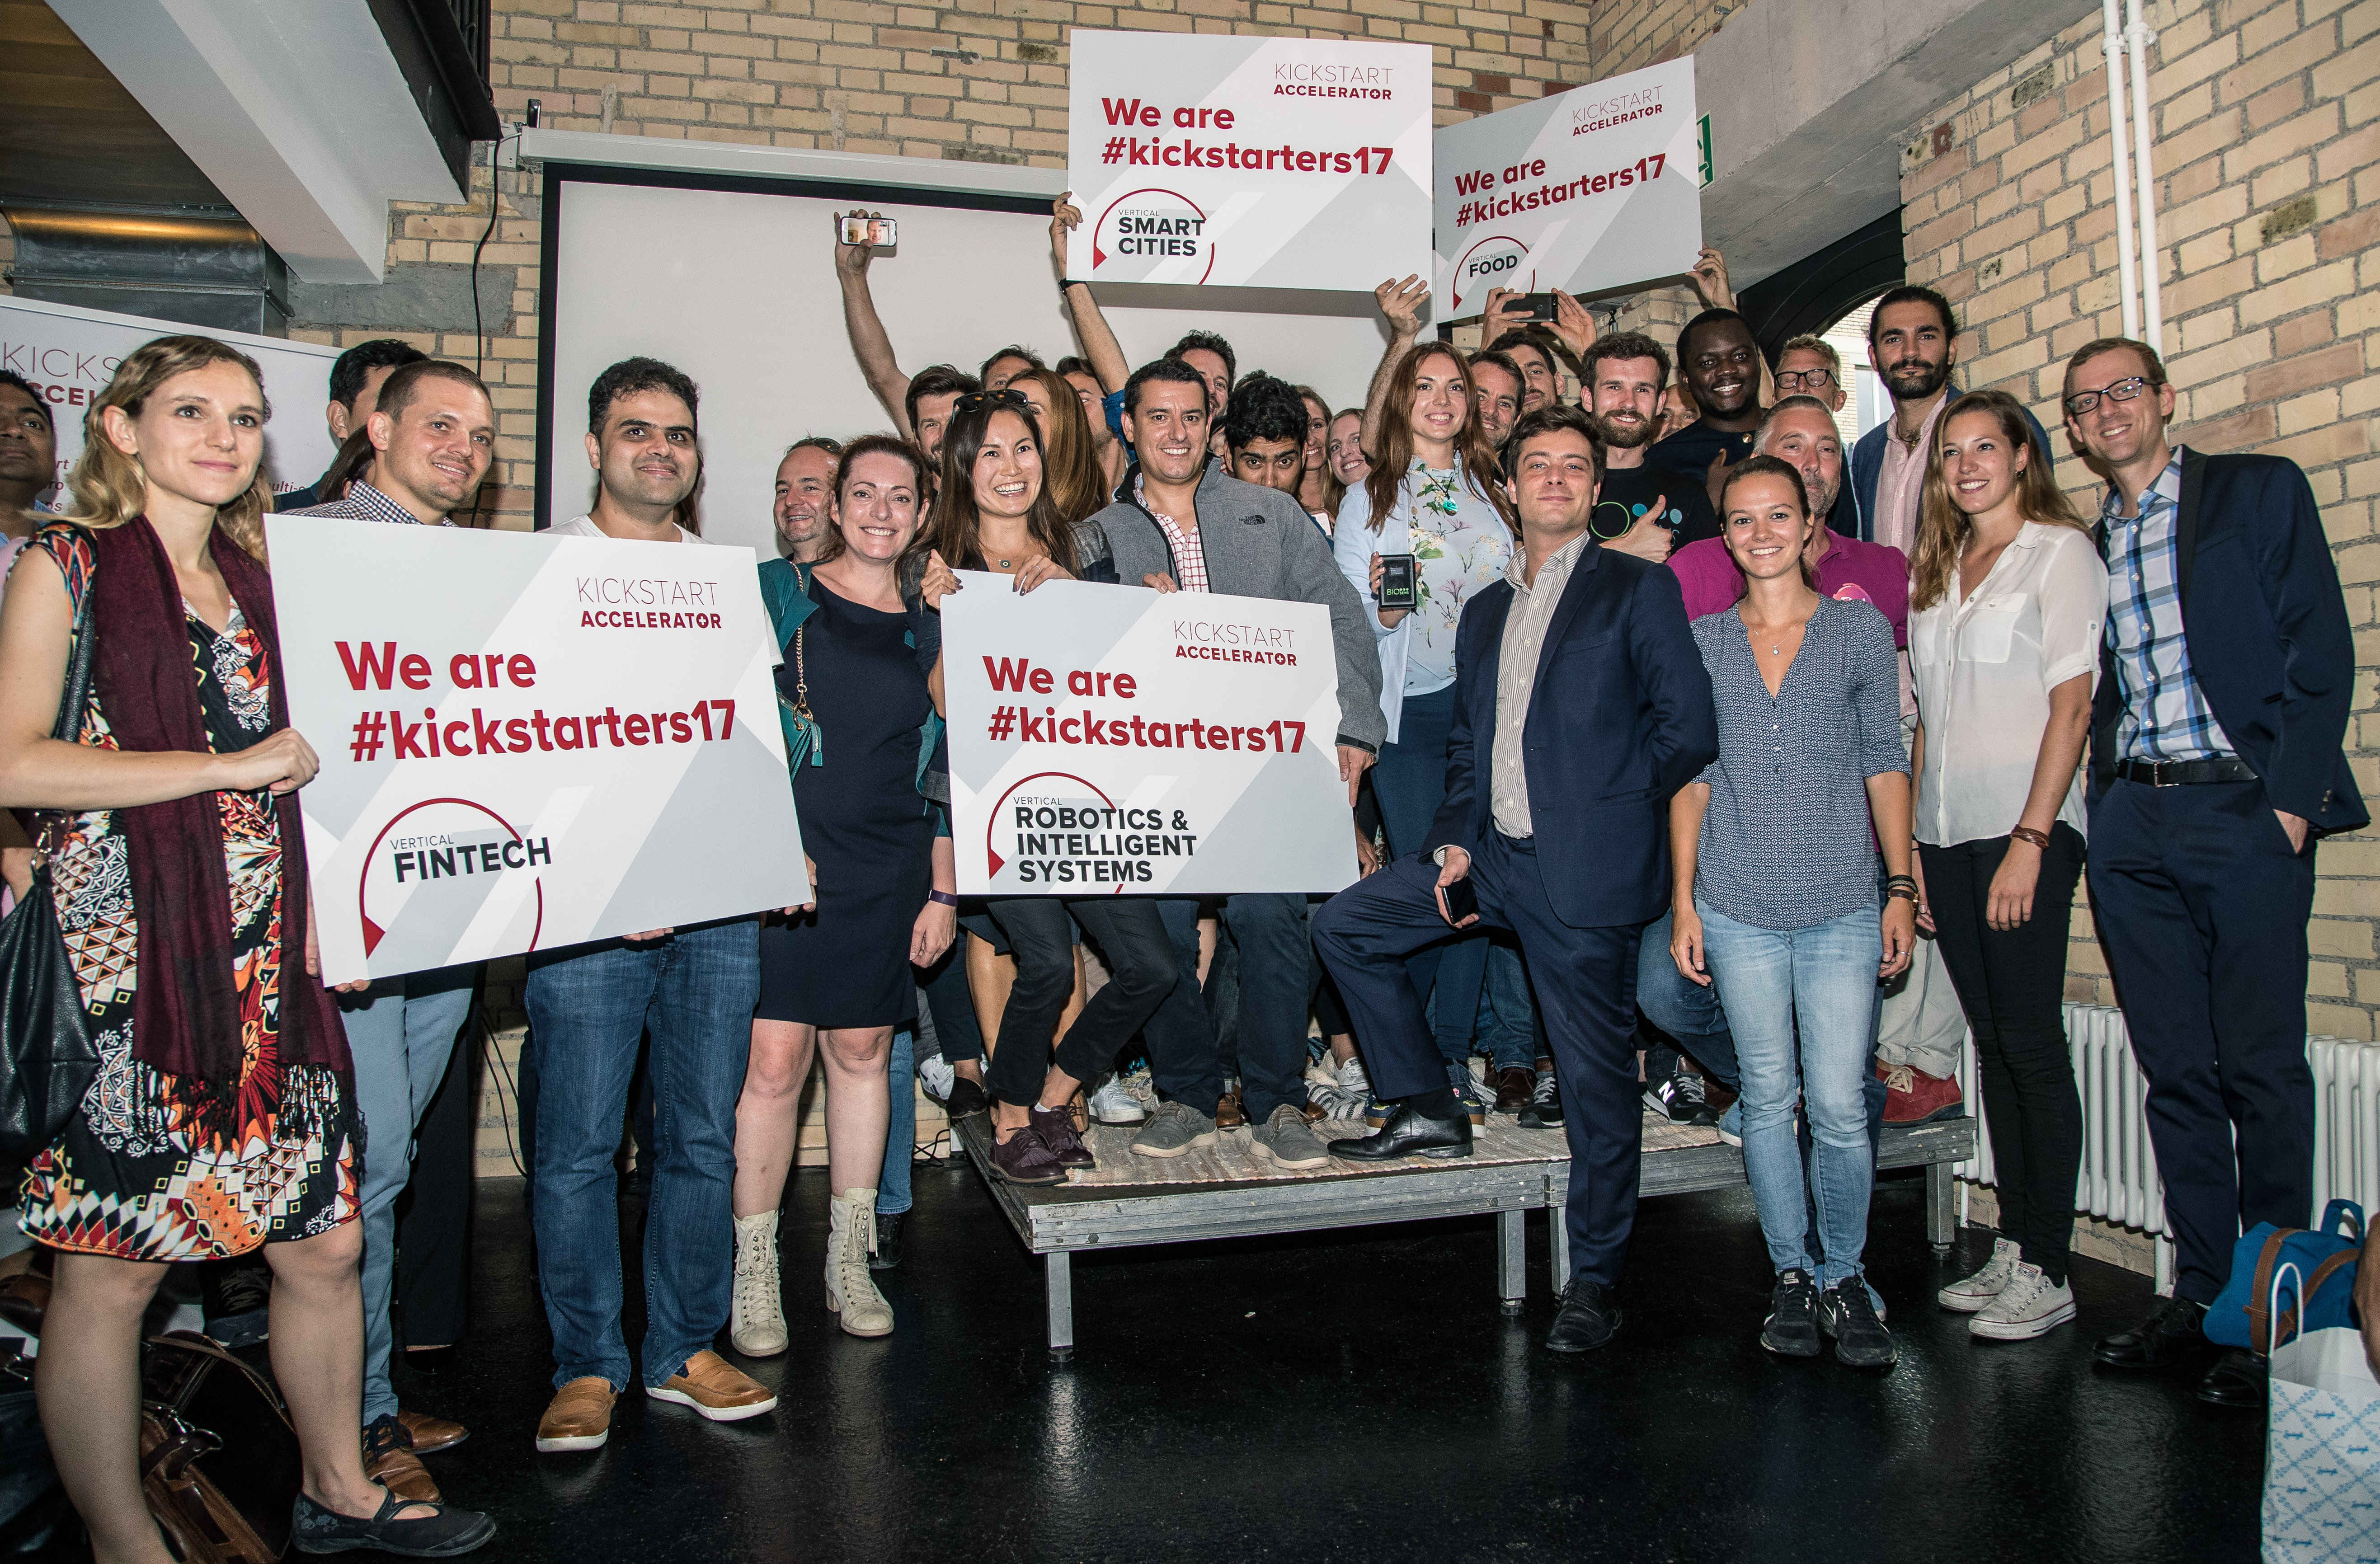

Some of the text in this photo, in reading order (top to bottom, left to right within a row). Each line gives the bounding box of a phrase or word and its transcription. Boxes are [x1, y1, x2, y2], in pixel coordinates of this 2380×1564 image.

[1275, 63, 1393, 84] KICKSTART
[1274, 84, 1392, 100] ACCELERATOR
[1572, 85, 1663, 123] KICKSTART
[1102, 98, 1235, 130] We are
[1572, 104, 1662, 136] ACCELERATOR
[1101, 137, 1393, 174] #kickstarters17
[1454, 159, 1546, 197] We are
[1456, 153, 1665, 228] #kickstarters17
[1118, 217, 1205, 236] SMART
[1118, 238, 1197, 256] CITIES
[1468, 253, 1496, 263] VERTICAL
[1469, 254, 1518, 277] FOOD
[577, 578, 718, 606] KICKSTART
[581, 611, 721, 629] ACCELERATOR
[1175, 620, 1295, 648] KICKSTART
[334, 642, 536, 690] We are
[1176, 646, 1297, 666] ACCELERATOR
[982, 656, 1137, 699] We are
[350, 699, 736, 761] #kickstarters17
[988, 706, 1306, 753] #kickstarters17
[1013, 796, 1062, 806] VERTICAL
[1016, 807, 1190, 831] ROBOTICS &
[390, 834, 454, 850] VERTICAL
[1018, 834, 1196, 856] INTELLIGENT
[394, 836, 552, 883] FINTECH
[1019, 860, 1152, 882] SYSTEMS
